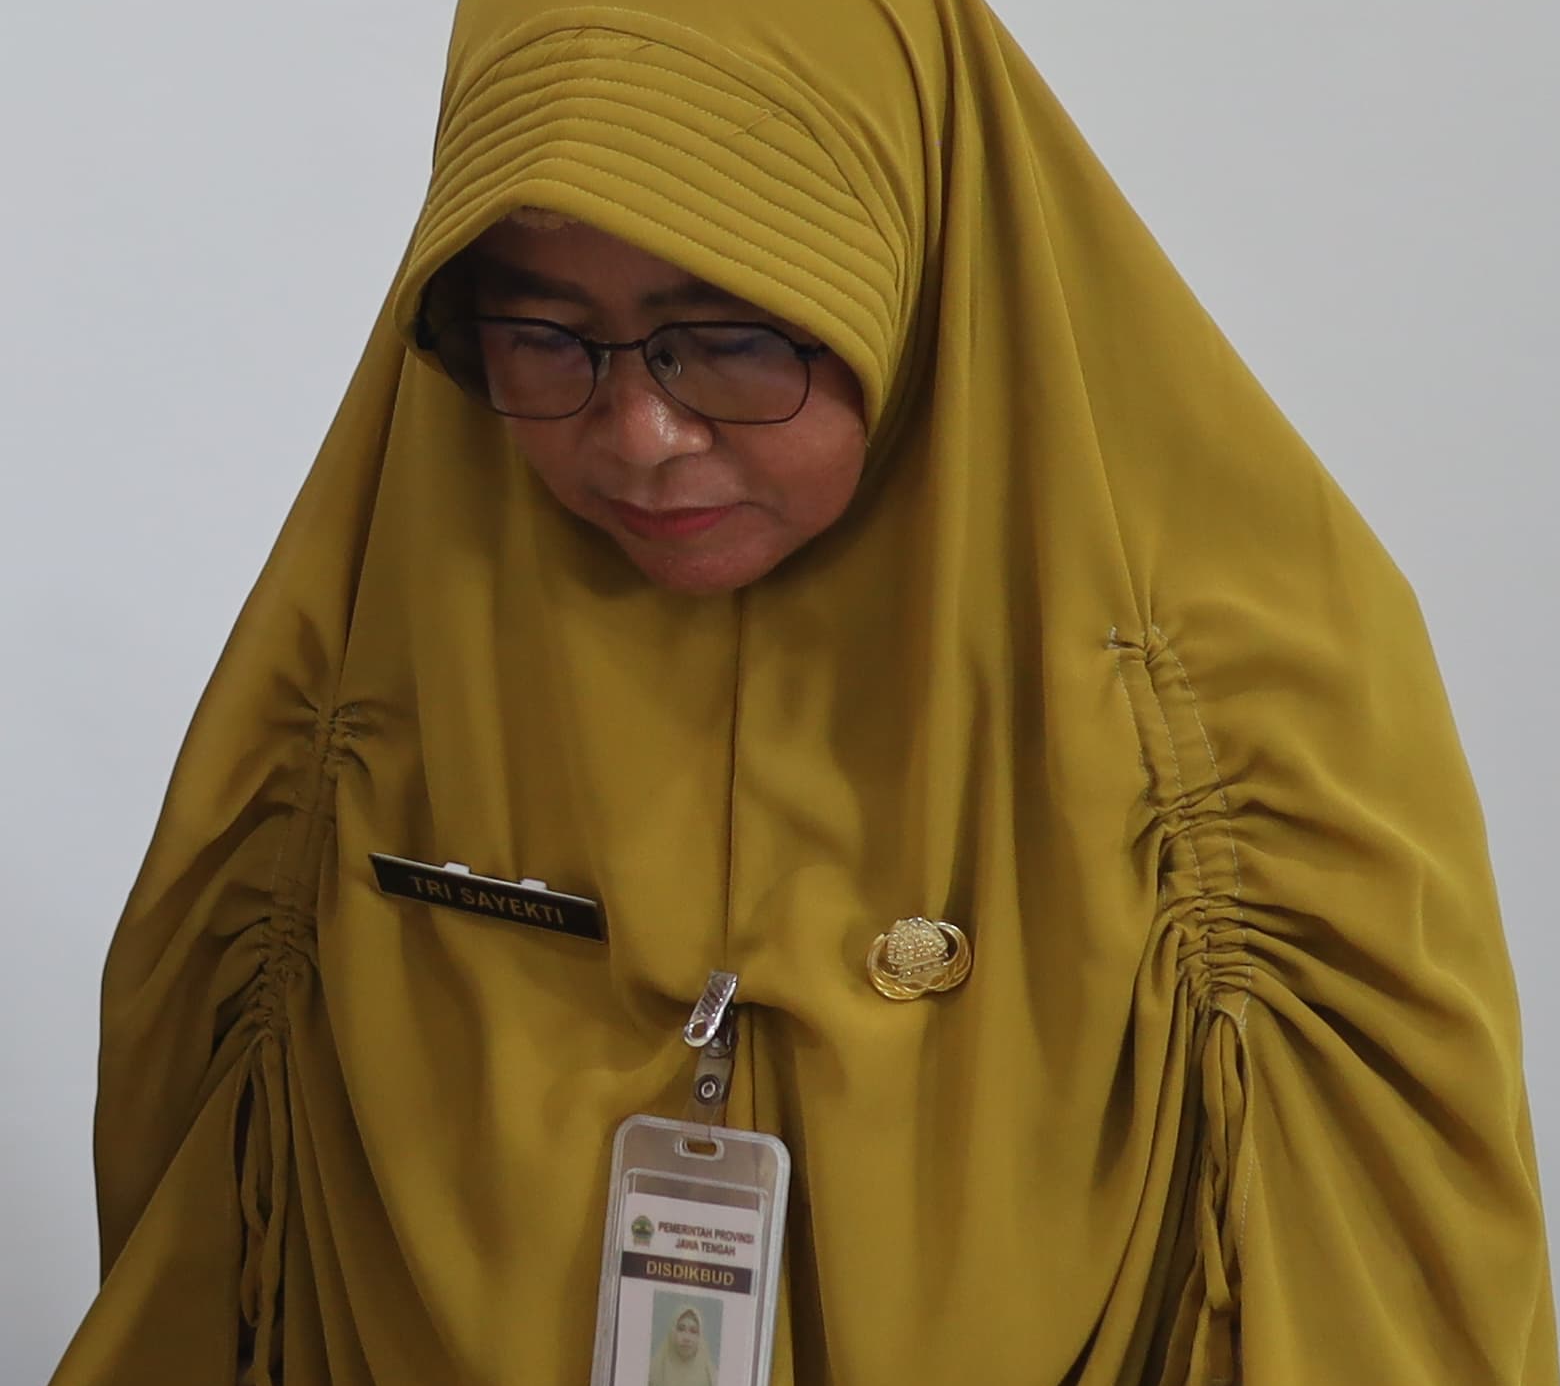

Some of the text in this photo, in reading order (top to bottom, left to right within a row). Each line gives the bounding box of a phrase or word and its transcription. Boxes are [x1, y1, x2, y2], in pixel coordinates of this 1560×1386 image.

[410, 876, 565, 925] TRI SAYEKTI
[658, 1221, 713, 1238] PEMERINTAH
[675, 1238, 736, 1257] JAWA TENGAH
[645, 1260, 734, 1286] DISDIKBUD
